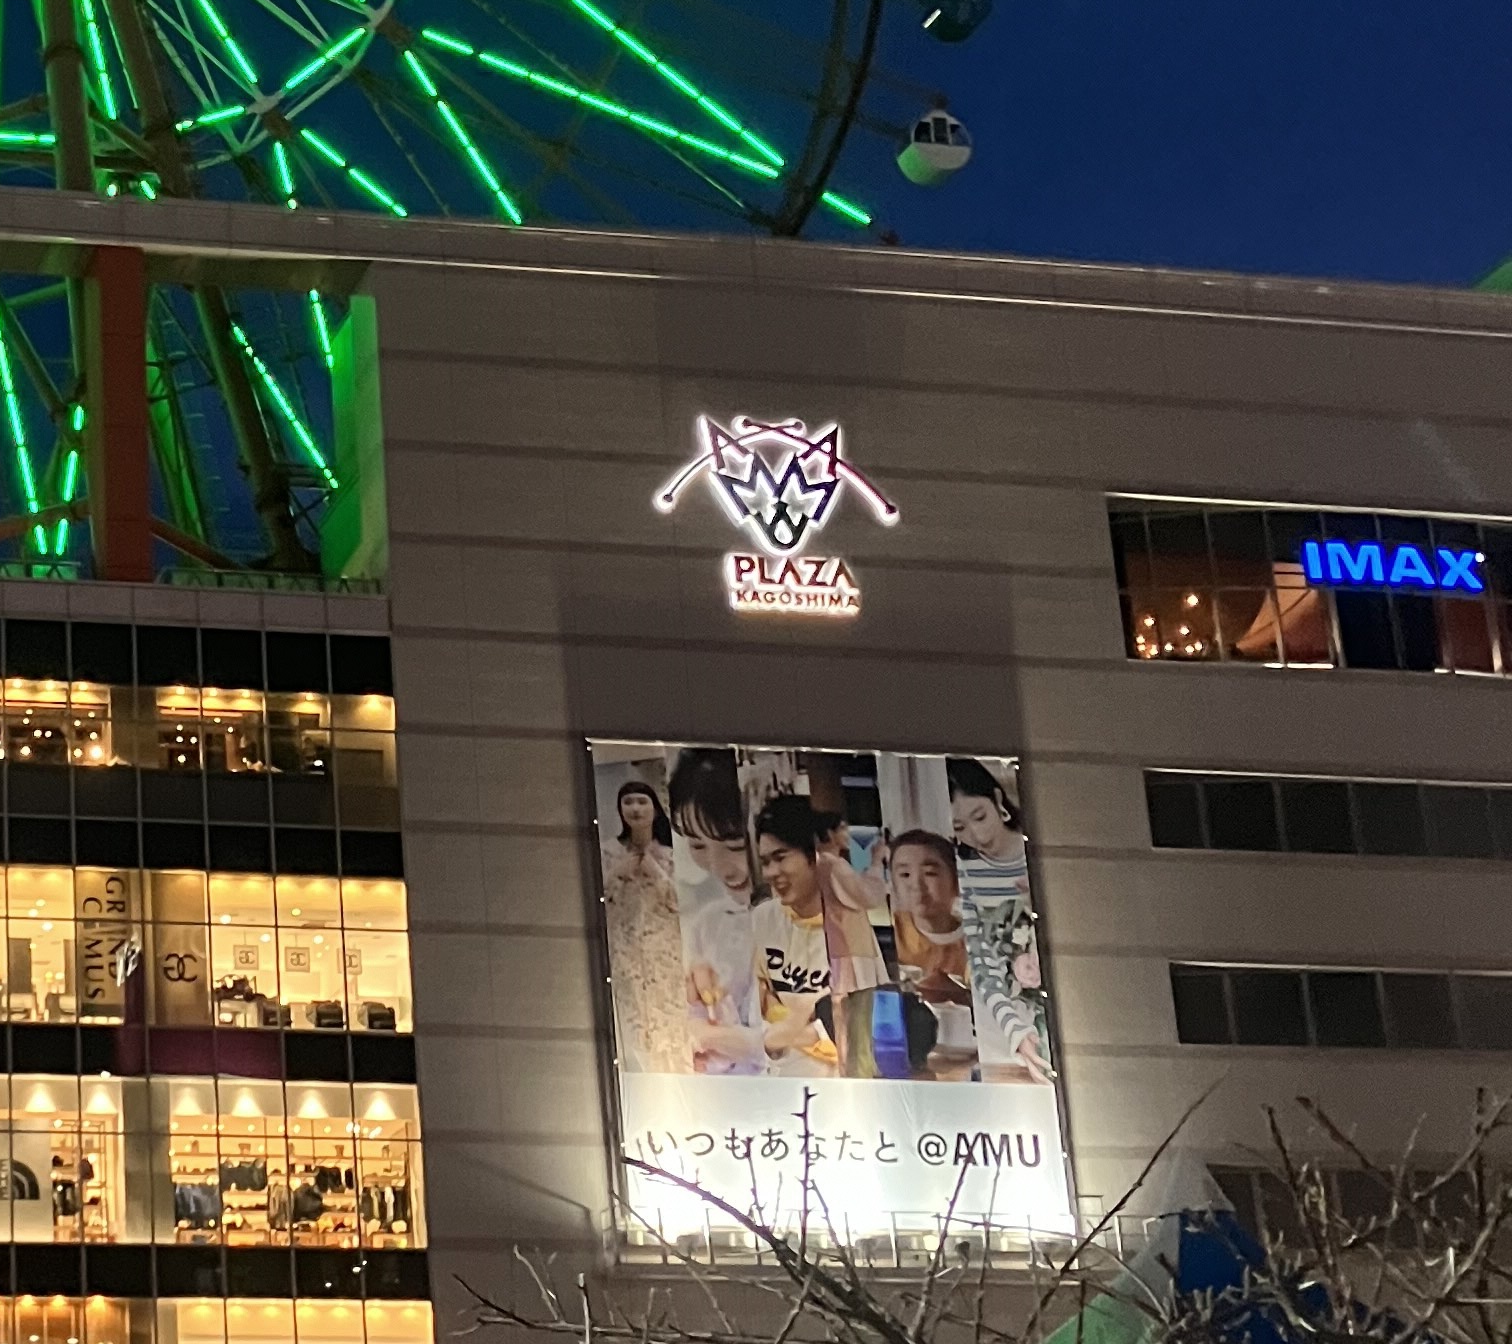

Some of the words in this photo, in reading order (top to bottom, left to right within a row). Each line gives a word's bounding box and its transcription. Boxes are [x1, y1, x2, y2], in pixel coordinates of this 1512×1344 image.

[731, 554, 860, 589] PLAZA
[1303, 540, 1484, 592] IMAX
[735, 590, 861, 608] KAGOSHIMA
[646, 1127, 899, 1162] いつもあなたと
[917, 1131, 1041, 1167] @AMU
